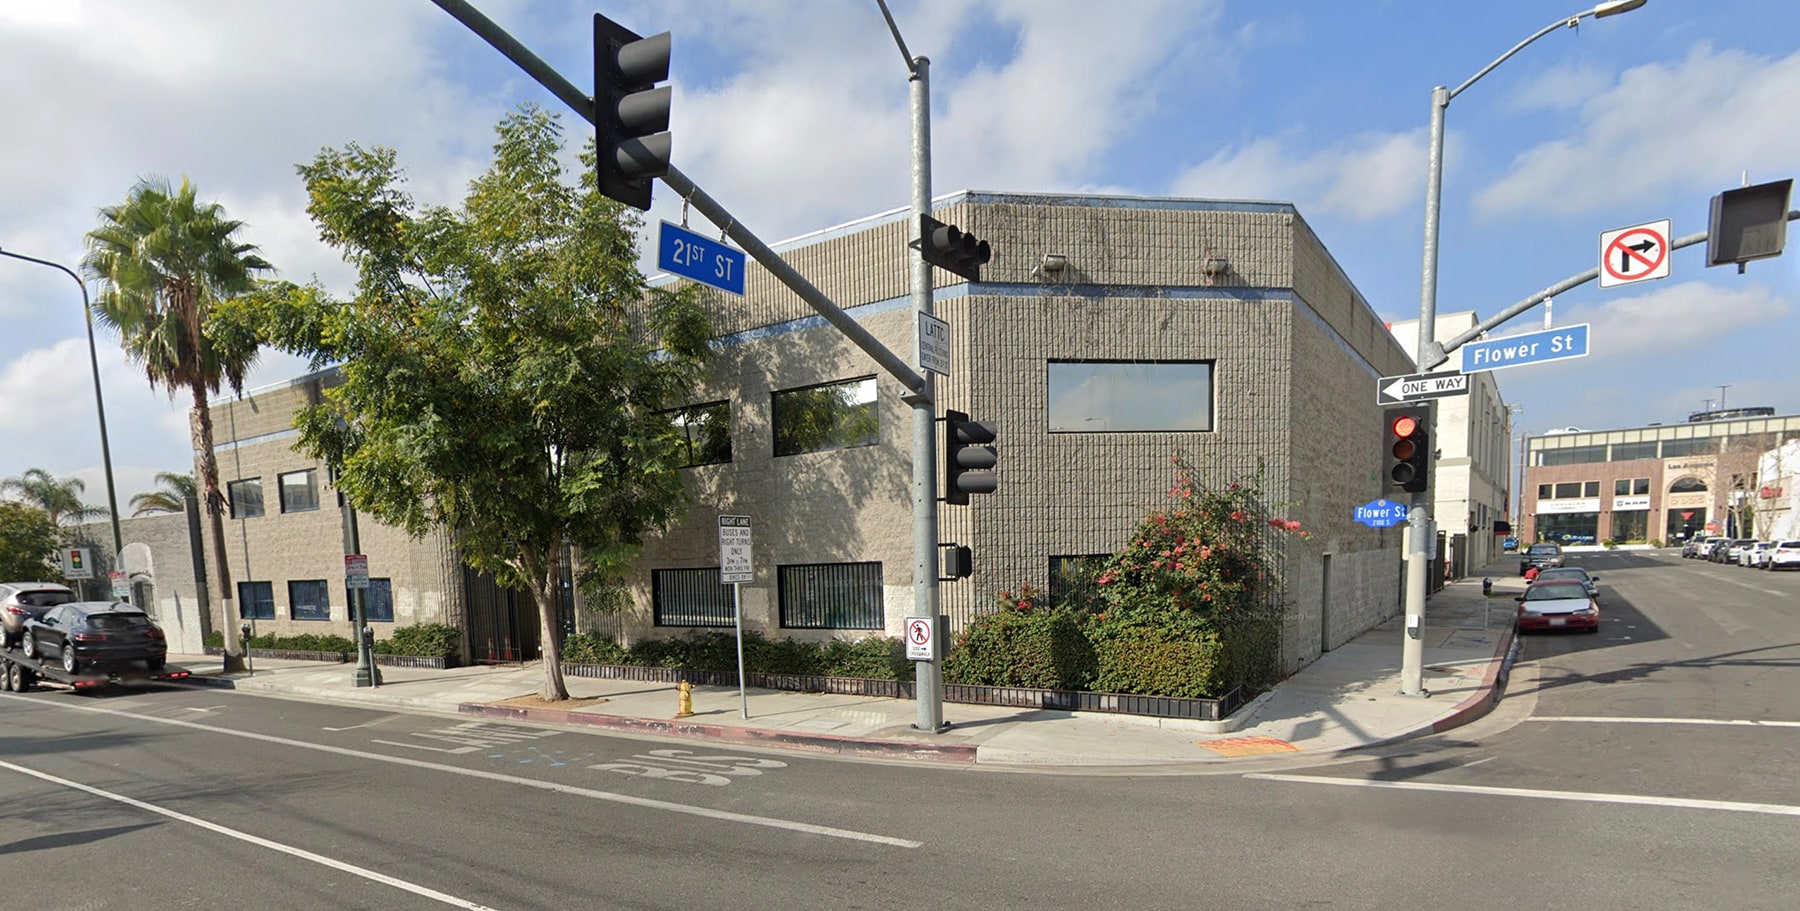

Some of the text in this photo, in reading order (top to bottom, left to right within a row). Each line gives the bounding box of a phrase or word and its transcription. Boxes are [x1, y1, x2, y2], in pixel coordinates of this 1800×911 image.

[672, 238, 733, 281] 21ST ST
[1474, 334, 1574, 365] Flower St
[1401, 376, 1463, 394] ONE WAY
[1358, 506, 1406, 518] Flower St
[736, 518, 749, 526] LANE
[722, 528, 749, 537] BUSES AND
[736, 538, 750, 546] TURNS
[586, 749, 789, 787] BUS
